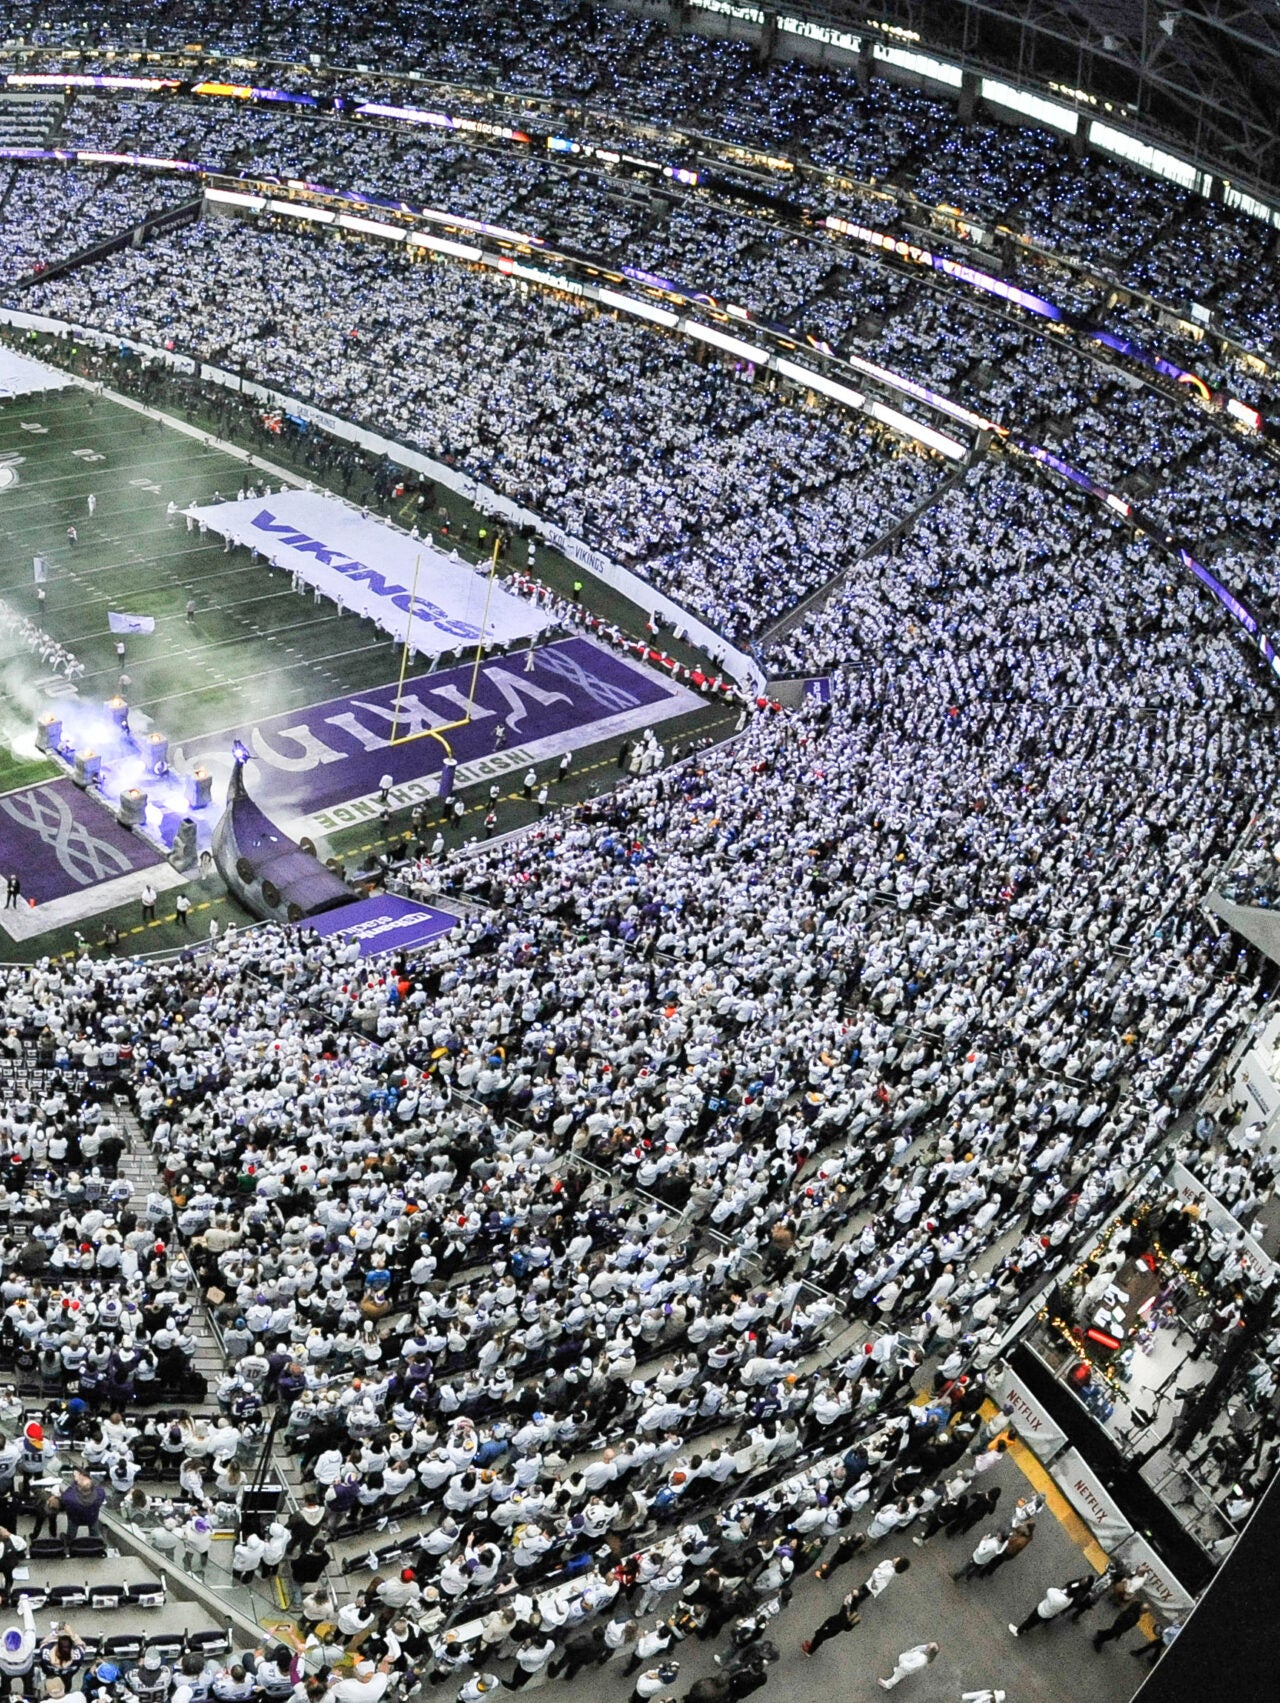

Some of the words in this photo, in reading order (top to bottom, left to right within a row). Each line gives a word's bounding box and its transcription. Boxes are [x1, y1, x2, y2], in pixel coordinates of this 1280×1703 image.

[250, 509, 495, 640] VIKINGS
[575, 544, 606, 574] VIKINGS
[442, 748, 535, 787] INSPIR
[312, 783, 431, 831] CHANGE
[1244, 1246, 1266, 1276] ETFLIX
[1006, 1389, 1042, 1433] NETFLIX
[1074, 1479, 1108, 1524] NETFLIX
